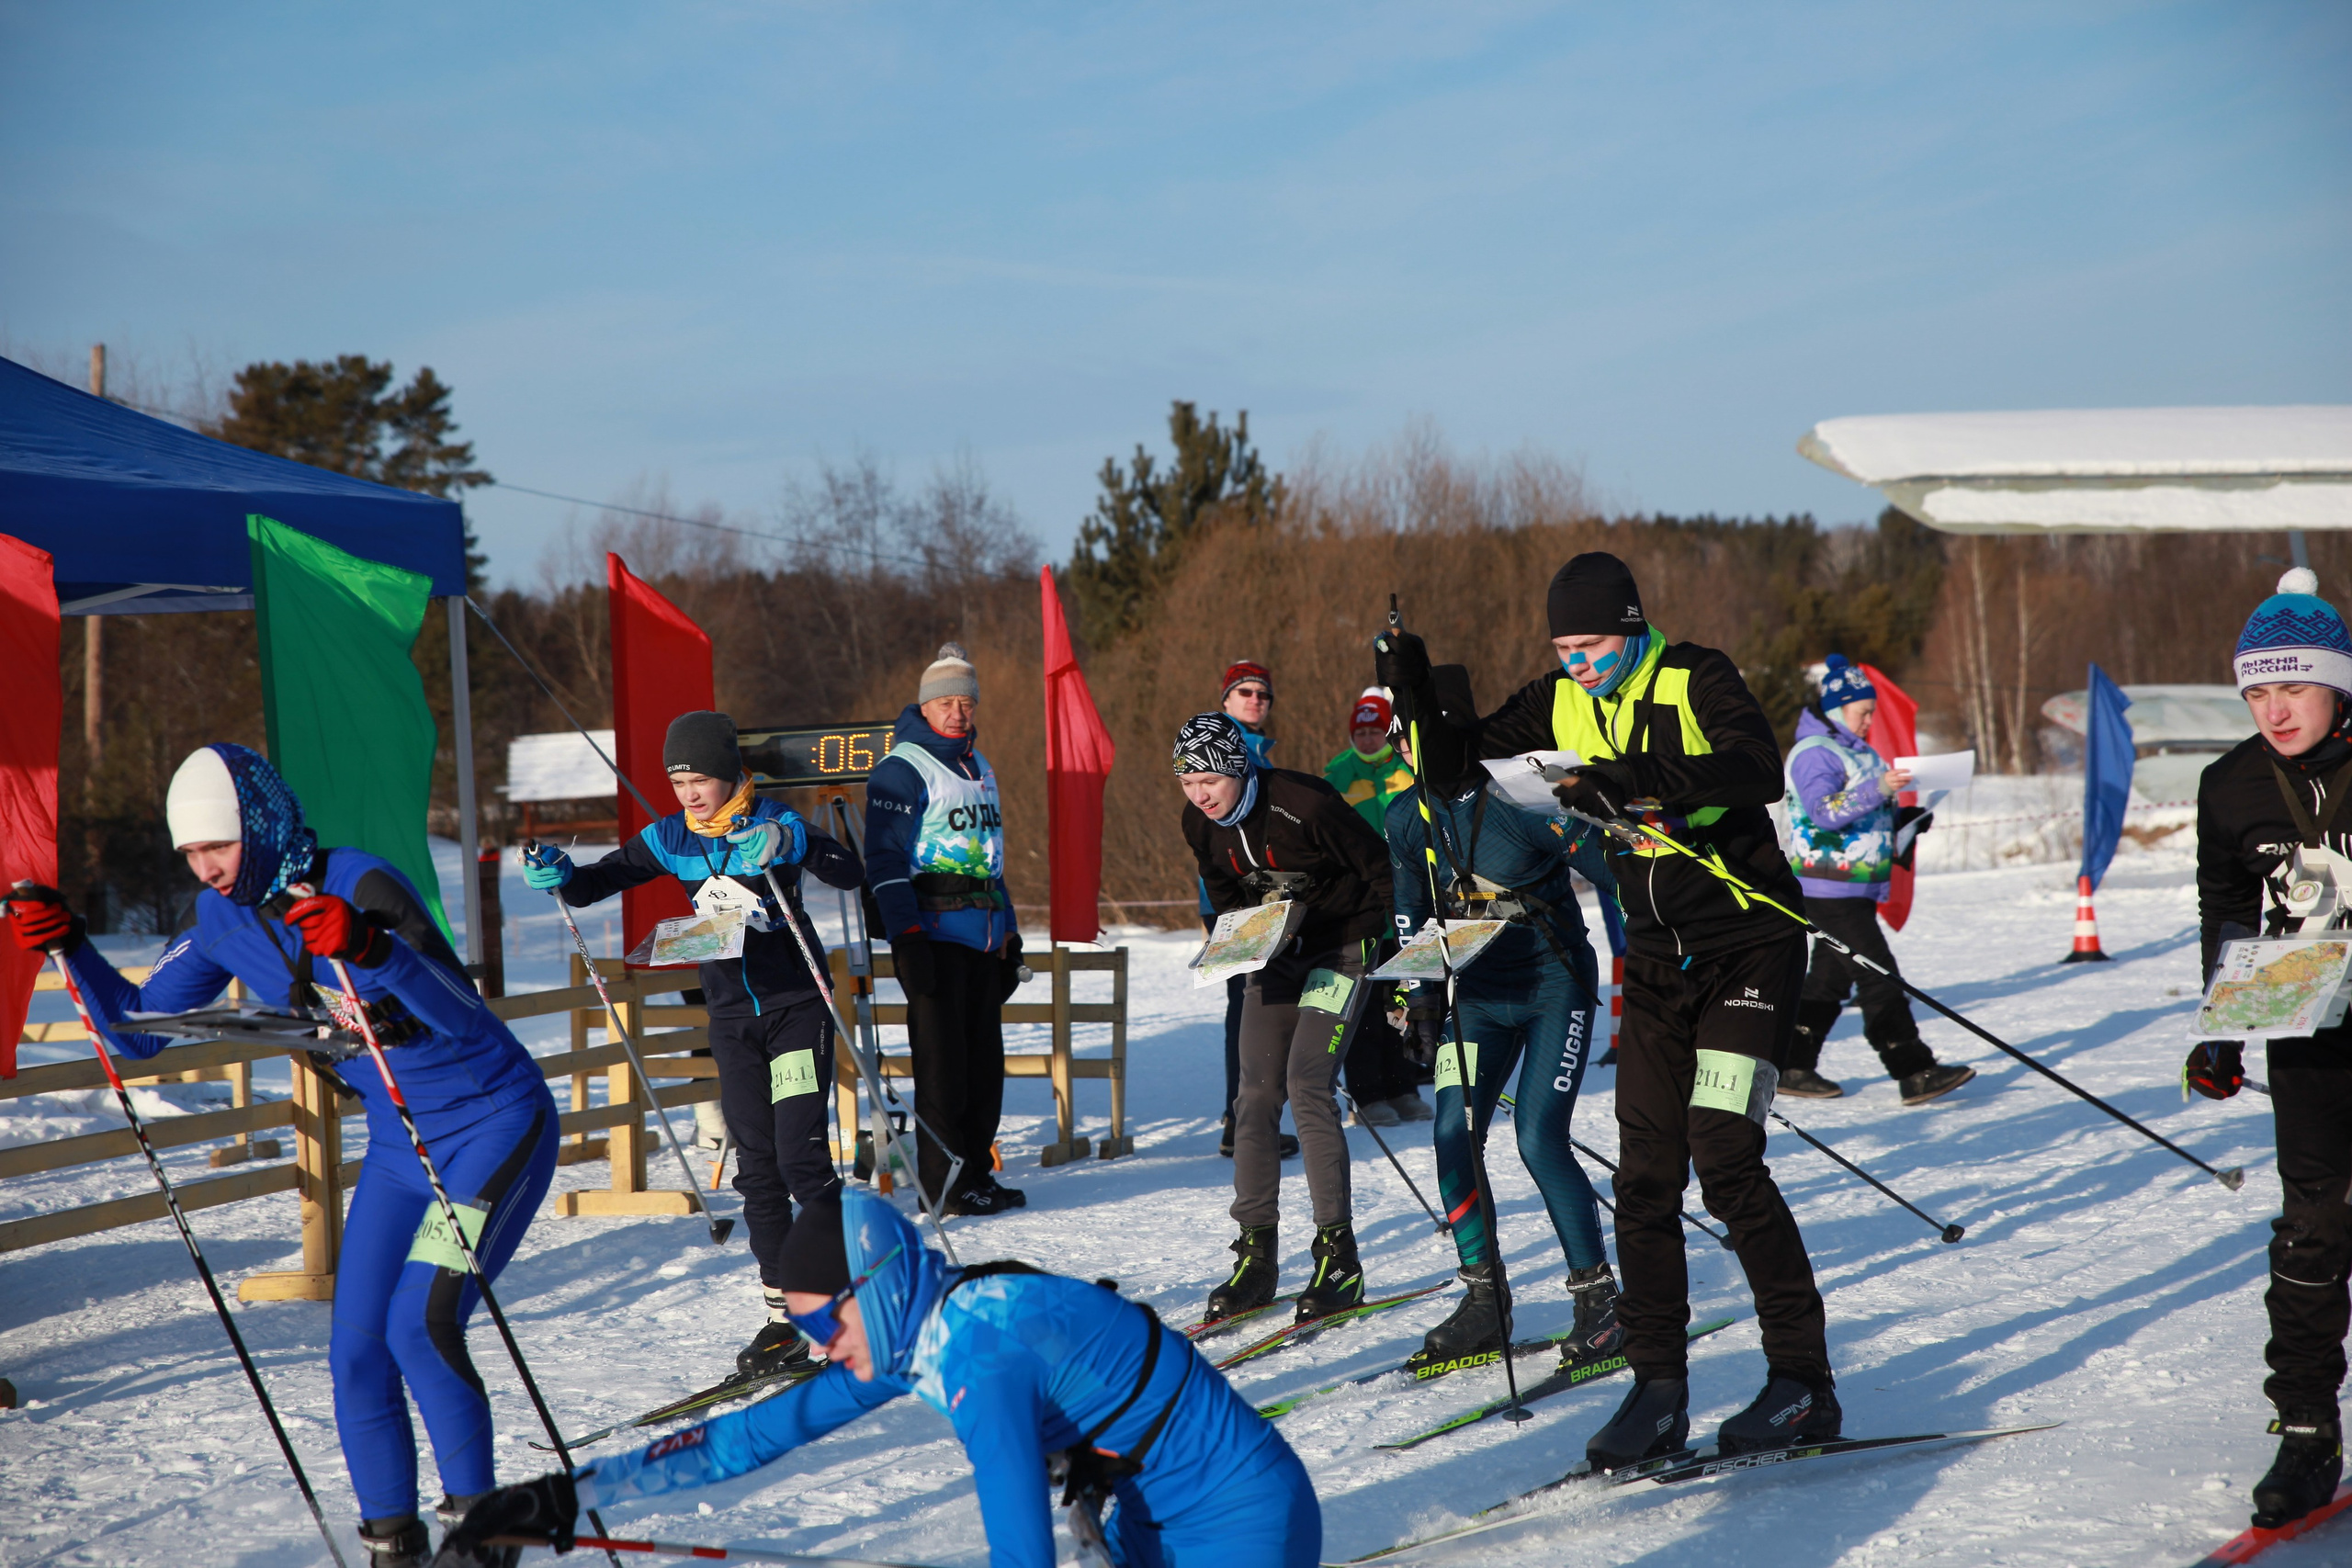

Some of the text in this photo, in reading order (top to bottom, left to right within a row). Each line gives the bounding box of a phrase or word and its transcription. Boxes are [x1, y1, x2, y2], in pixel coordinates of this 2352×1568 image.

[2241, 656, 2299, 670] ЛЫЖНЯ
[2241, 664, 2299, 678] РОССИИ
[873, 798, 912, 815] MOAX
[1270, 805, 1302, 825] noname
[1724, 999, 1774, 1011] NORDSKI
[1328, 1023, 1345, 1055] FILA
[1554, 1010, 1586, 1093] O-UGRA
[1695, 1068, 1738, 1091] 211.1
[1328, 1268, 1346, 1283] TREK
[1416, 1350, 1502, 1380] BRADOS
[1769, 1393, 1813, 1427] SPINE
[1702, 1451, 1787, 1476] FISCHER
